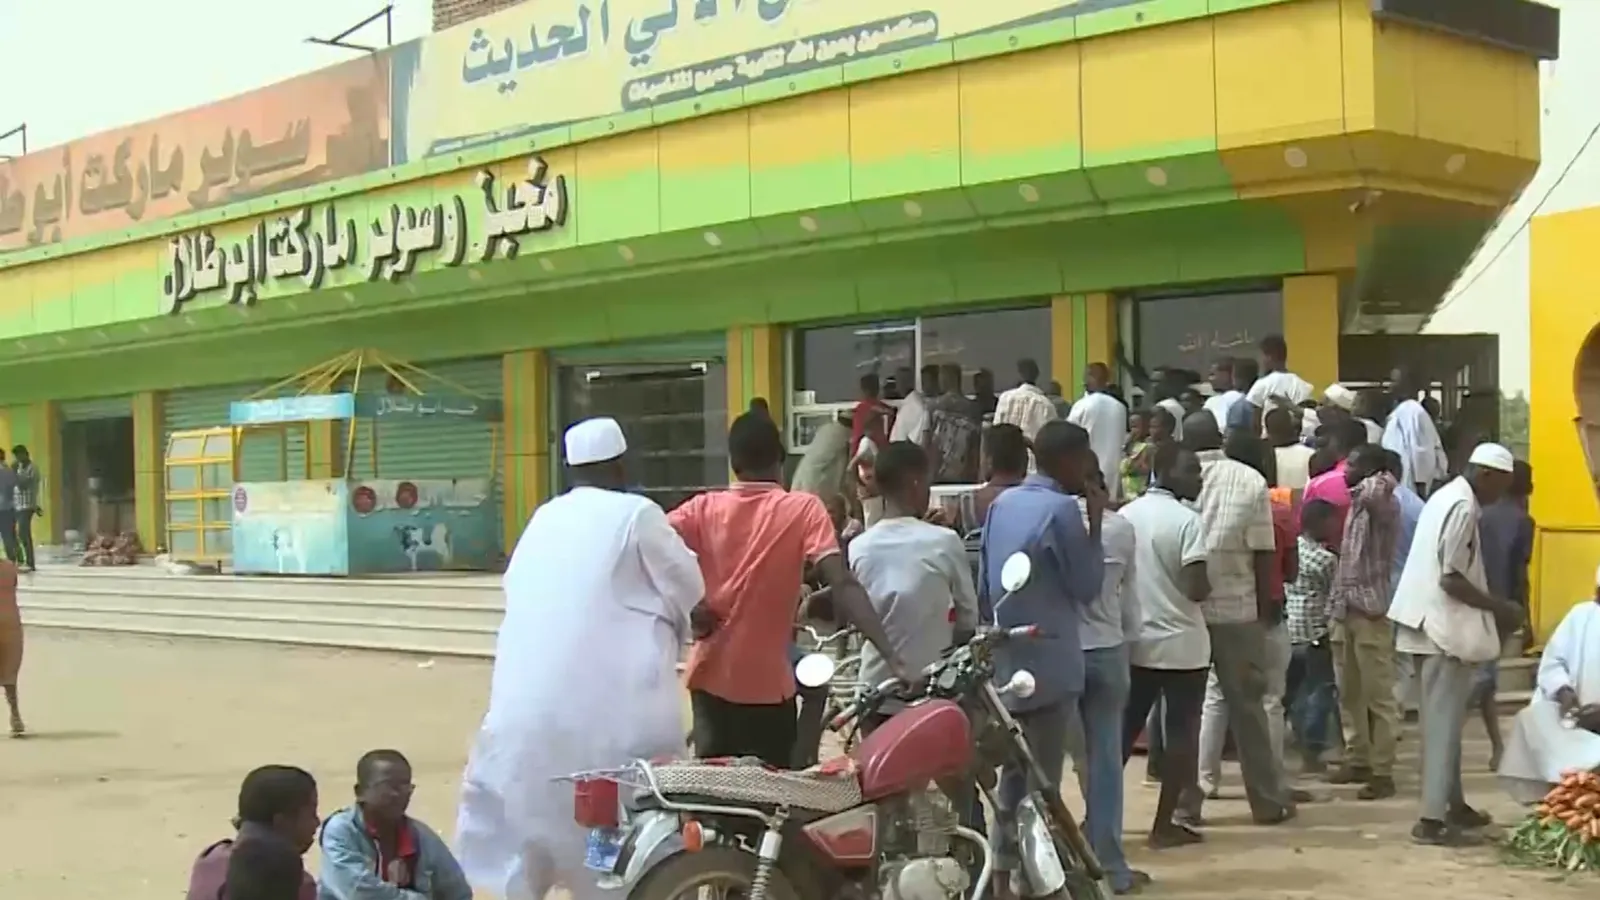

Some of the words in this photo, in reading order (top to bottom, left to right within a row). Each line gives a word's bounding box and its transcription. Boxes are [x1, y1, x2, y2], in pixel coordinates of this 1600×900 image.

[462, 0, 610, 94] الحديث
[786, 39, 814, 63] الله
[79, 133, 185, 222] ماركت
[186, 114, 312, 210] سوبر
[267, 200, 357, 291] ماركت
[468, 155, 569, 263] مخبز
